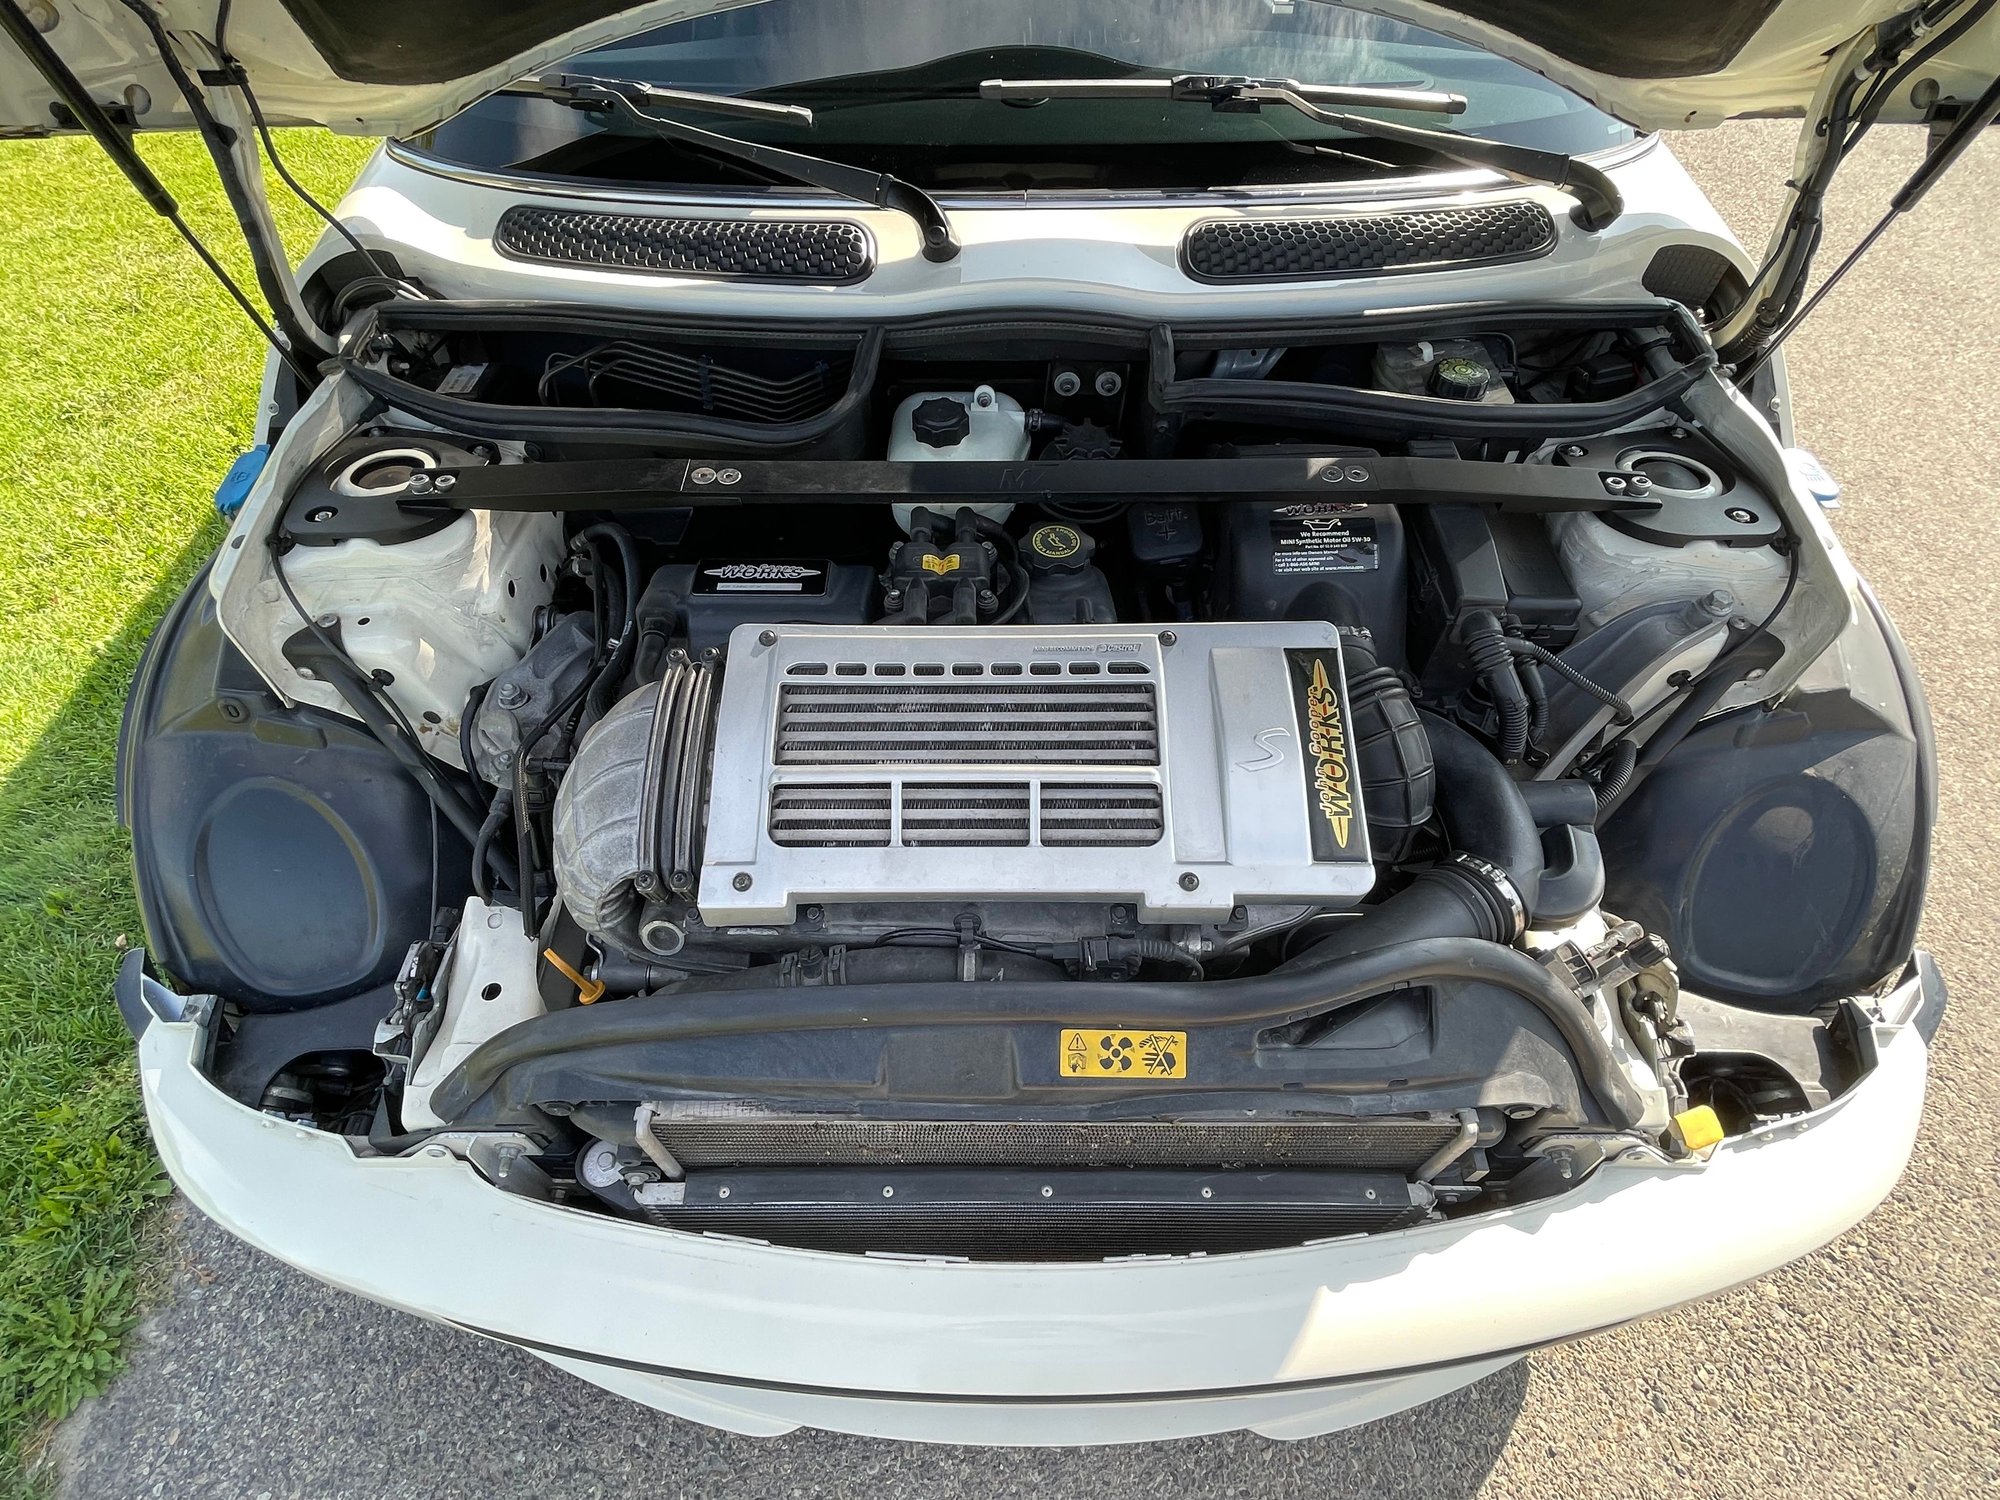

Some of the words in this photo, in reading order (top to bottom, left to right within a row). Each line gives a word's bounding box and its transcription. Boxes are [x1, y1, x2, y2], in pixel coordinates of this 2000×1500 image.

[1295, 537, 1323, 546] Synthetic
[720, 565, 804, 579] WORKS
[1308, 685, 1324, 756] Cooper
[1234, 727, 1291, 772] S
[1317, 687, 1353, 819] WORKS
[1315, 767, 1335, 817] John
